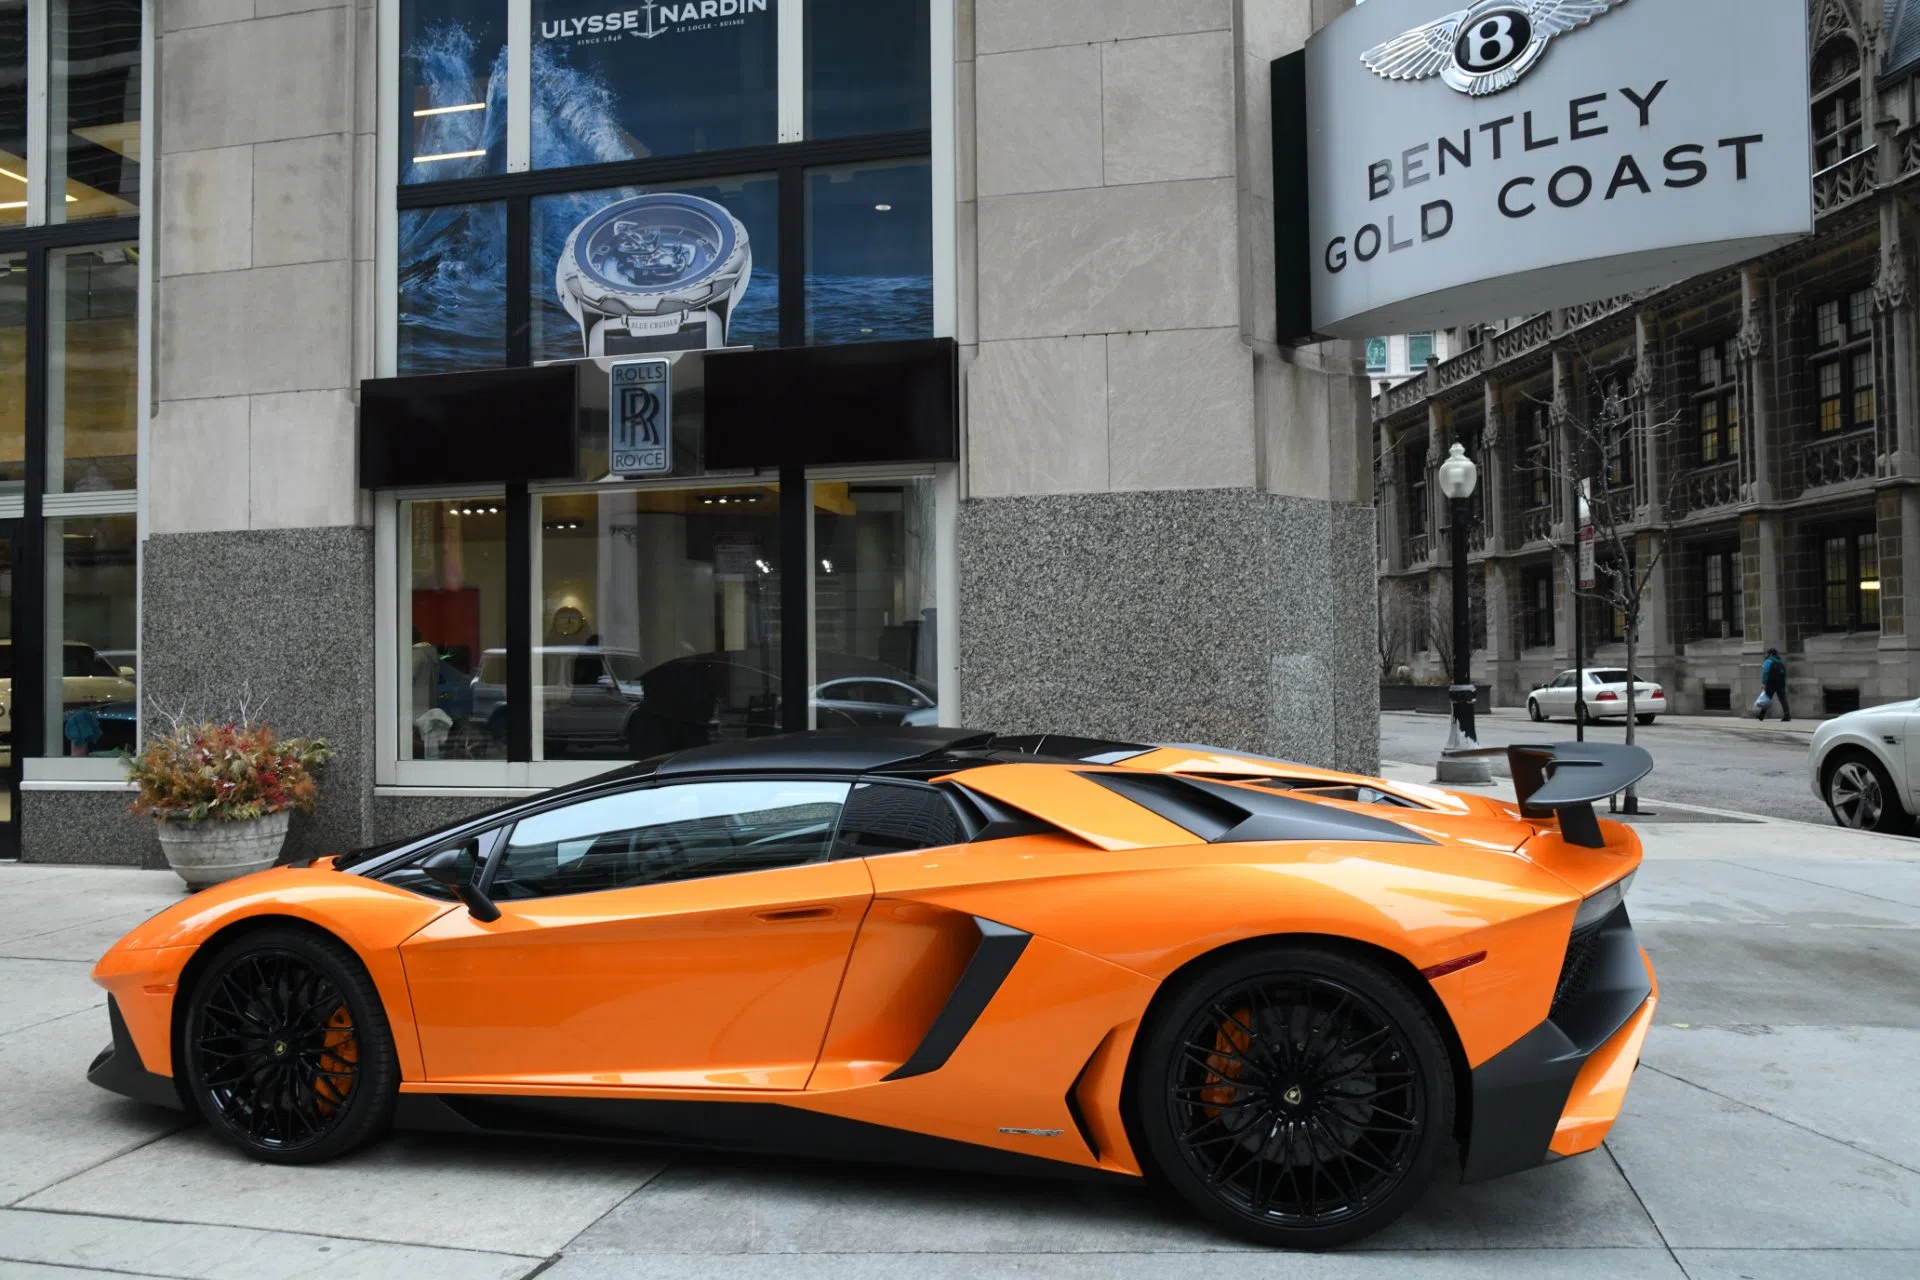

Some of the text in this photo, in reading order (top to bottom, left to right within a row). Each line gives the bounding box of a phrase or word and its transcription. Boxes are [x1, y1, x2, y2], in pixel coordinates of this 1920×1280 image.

[541, 0, 767, 39] ULYSSE NARDIN
[688, 23, 712, 31] LOCLE
[720, 18, 744, 27] SUISSE
[577, 34, 622, 45] SINCE 1846
[1466, 15, 1514, 67] B
[1368, 79, 1669, 202] BENTLEY
[1325, 134, 1764, 274] GOLD COAST
[615, 366, 663, 381] ROLLS
[615, 452, 663, 468] ROYCE
